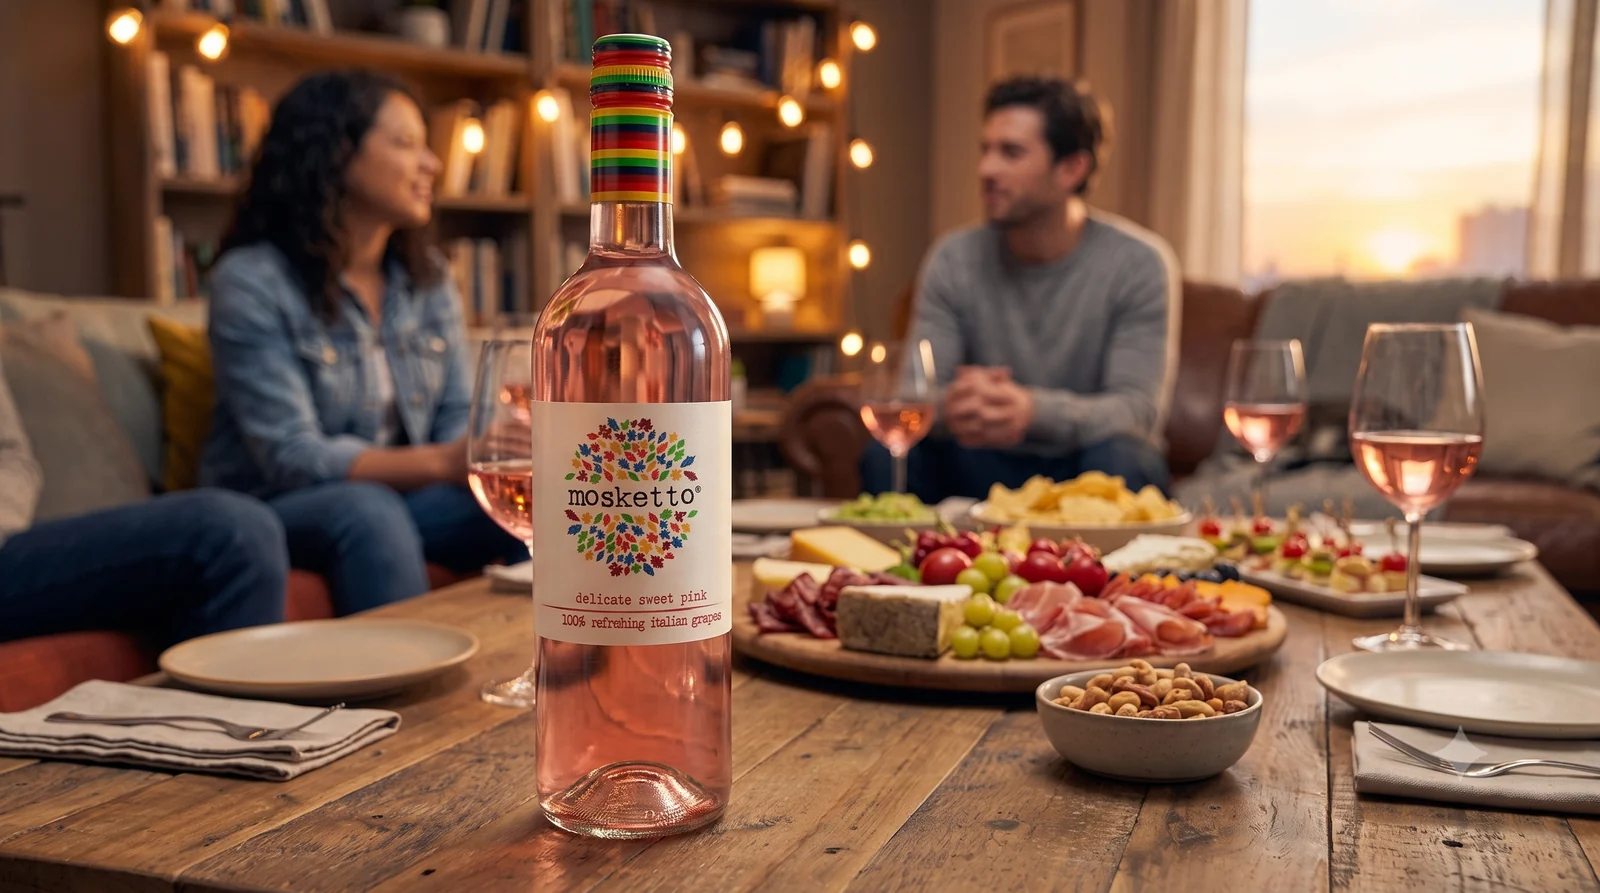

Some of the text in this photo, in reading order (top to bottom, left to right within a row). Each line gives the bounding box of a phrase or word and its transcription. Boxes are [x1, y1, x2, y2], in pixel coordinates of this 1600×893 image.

[575, 590, 708, 606] delicate sweet pink
[562, 614, 586, 627] 100%
[650, 615, 688, 629] italian
[691, 611, 722, 628] grapes
